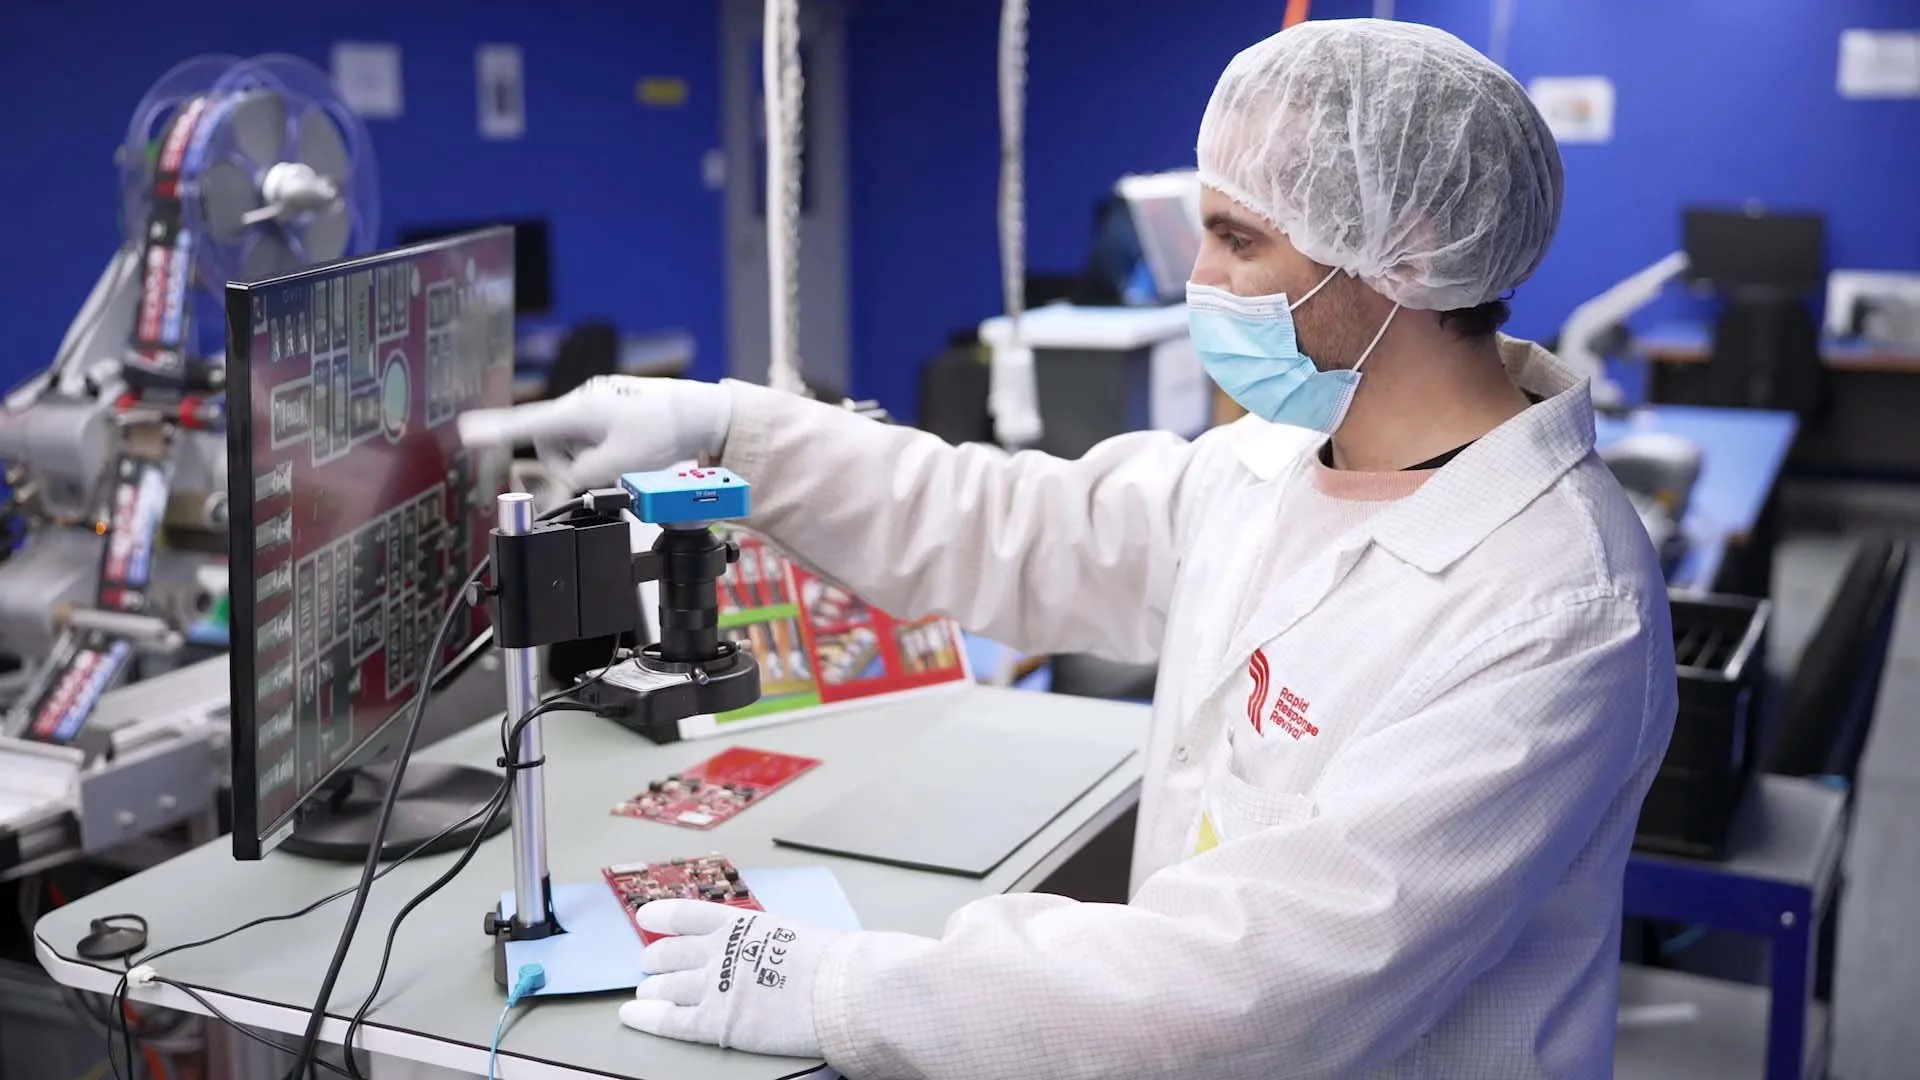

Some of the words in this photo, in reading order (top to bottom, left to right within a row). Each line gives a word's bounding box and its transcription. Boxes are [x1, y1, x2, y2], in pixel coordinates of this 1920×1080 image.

[1279, 687, 1310, 713] Rapid
[1269, 710, 1302, 741] Revival
[1274, 698, 1319, 736] Response
